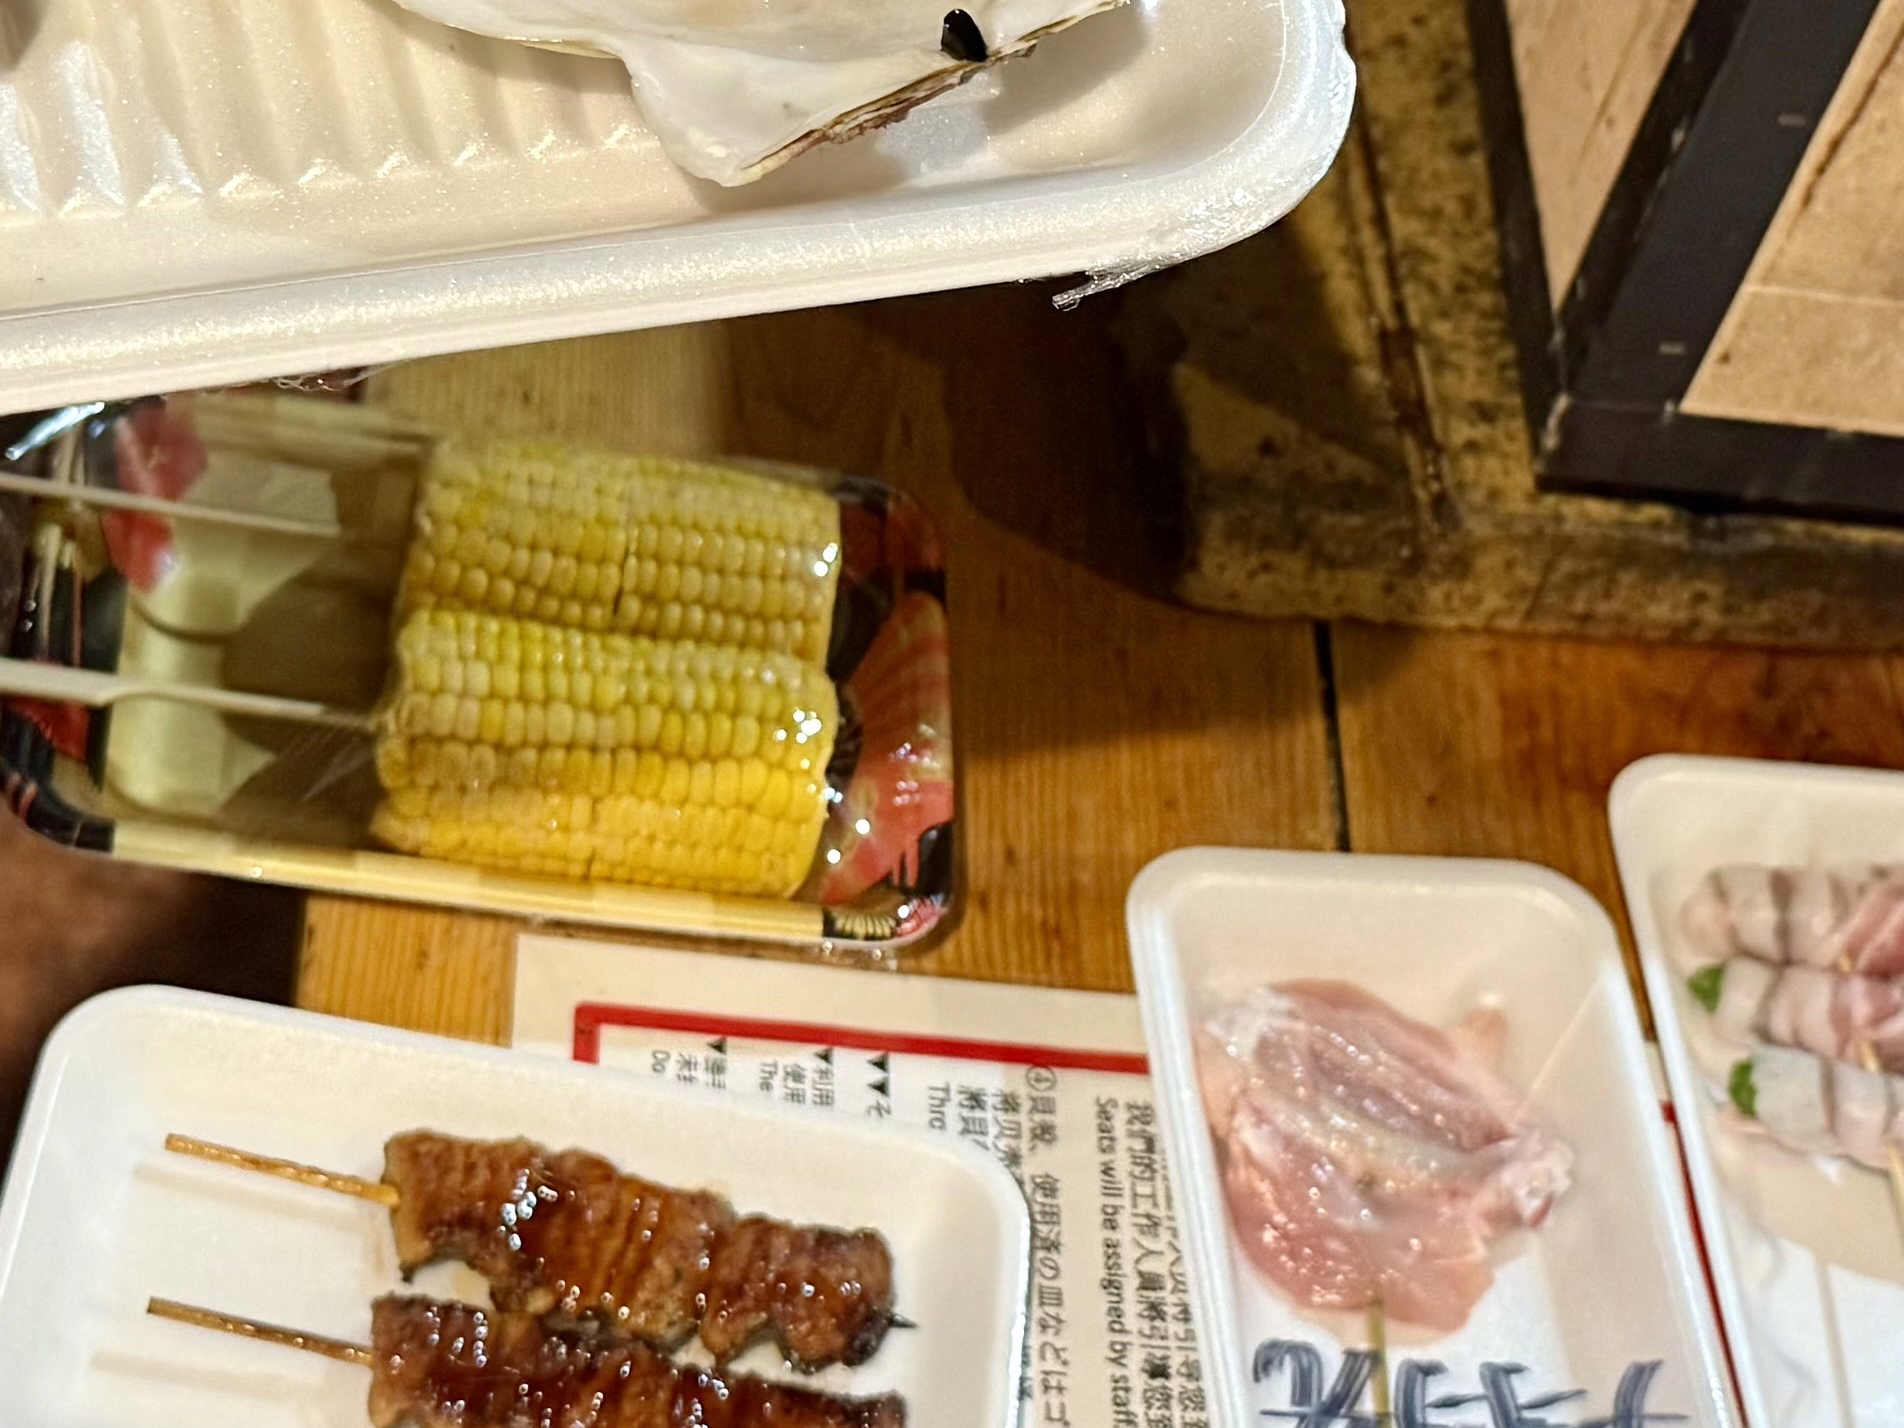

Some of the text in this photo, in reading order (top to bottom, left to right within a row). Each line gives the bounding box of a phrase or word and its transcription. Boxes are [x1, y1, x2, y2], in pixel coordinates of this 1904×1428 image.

[1095, 1098, 1122, 1154] Seats
[1100, 1159, 1124, 1197] will
[1102, 1204, 1126, 1232] be
[1100, 1238, 1132, 1334] assigned
[1105, 1340, 1133, 1368] by
